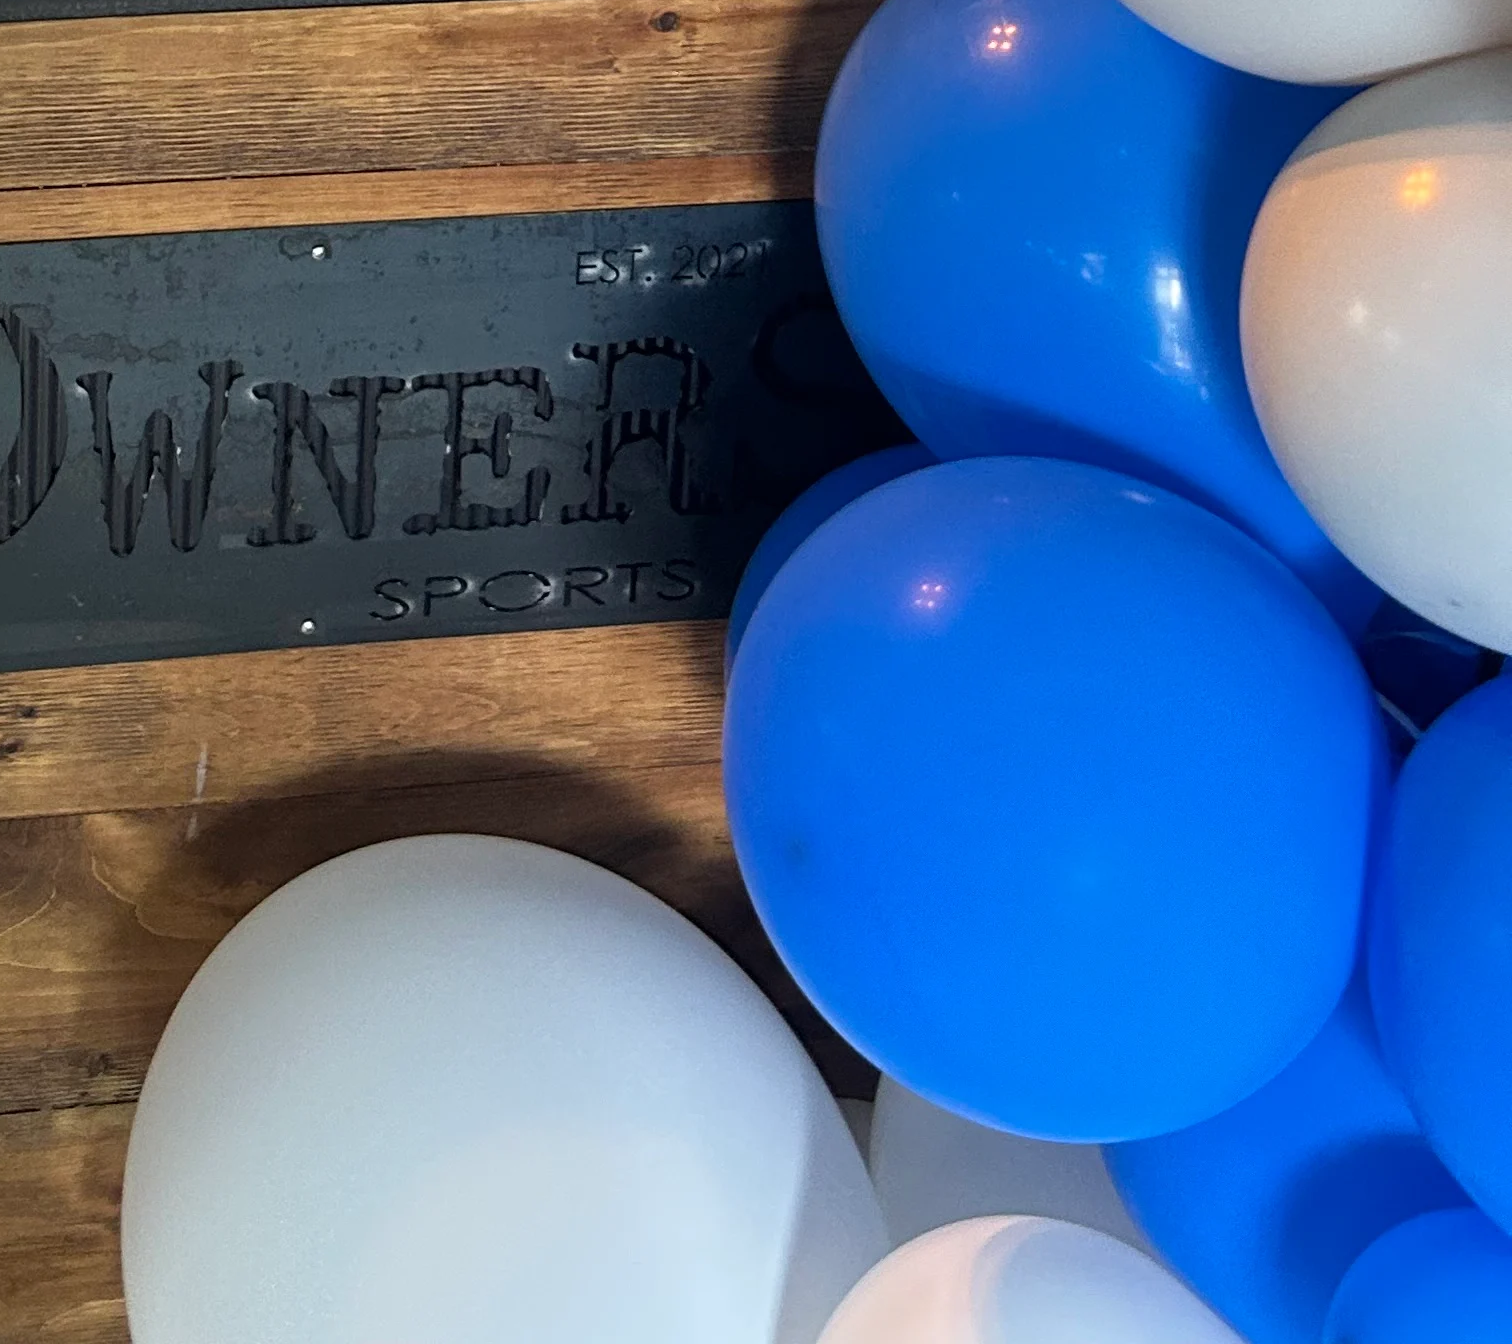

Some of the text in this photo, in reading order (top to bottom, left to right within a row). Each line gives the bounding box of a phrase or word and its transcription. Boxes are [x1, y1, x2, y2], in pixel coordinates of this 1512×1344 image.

[575, 241, 772, 286] EST. 2021
[369, 558, 698, 621] SPORTS
